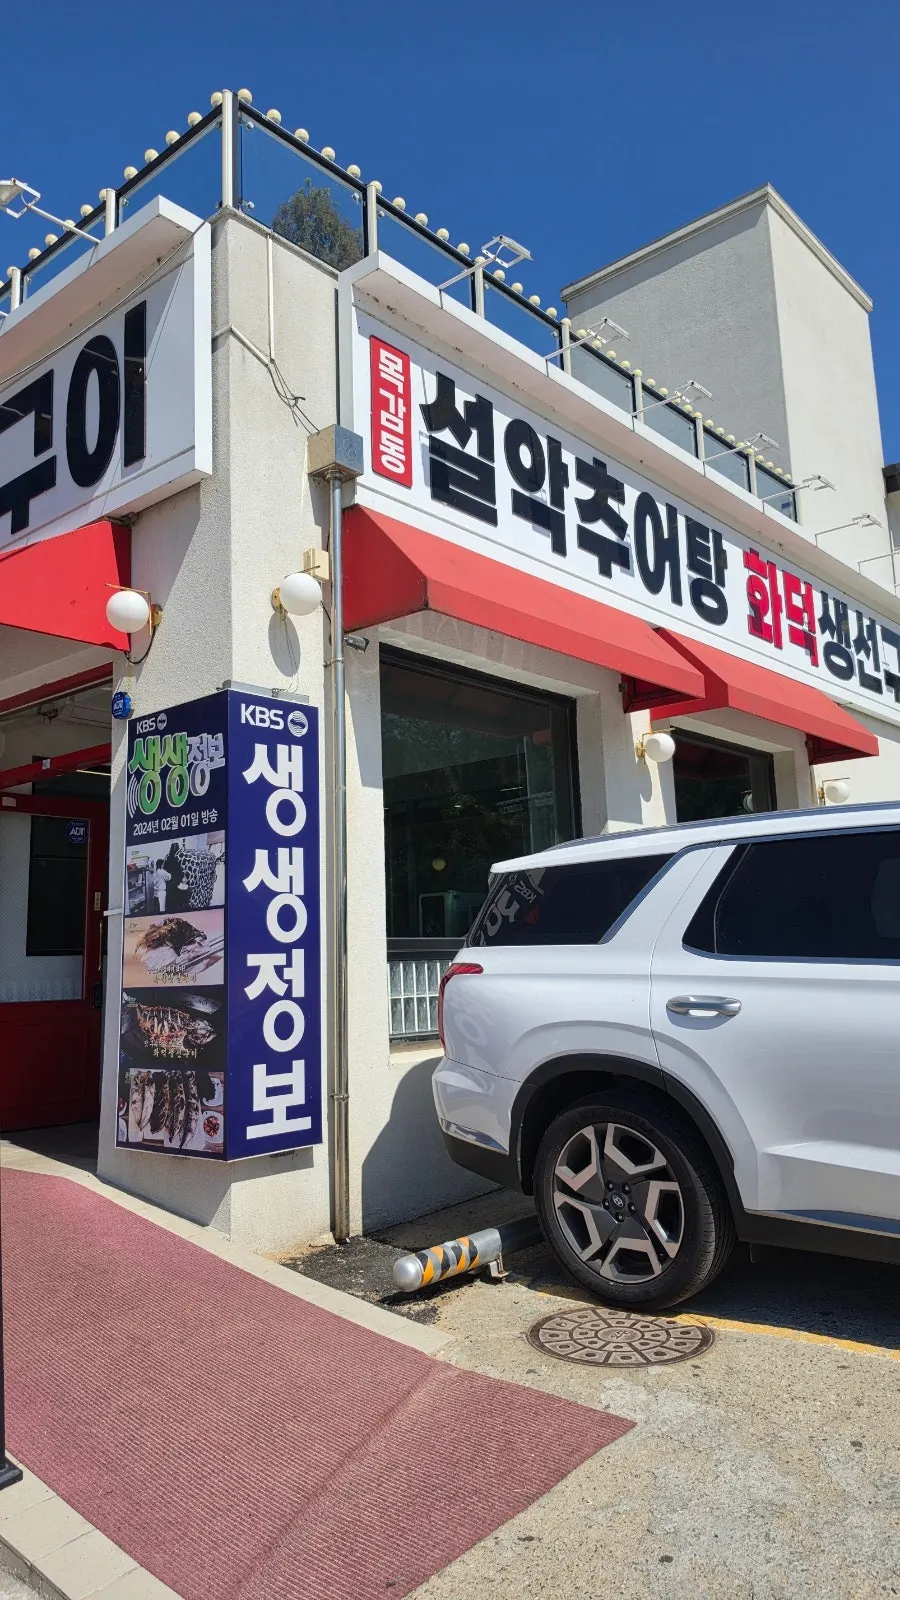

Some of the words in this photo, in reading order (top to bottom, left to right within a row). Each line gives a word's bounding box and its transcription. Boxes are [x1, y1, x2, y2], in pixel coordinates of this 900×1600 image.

[379, 348, 406, 475] 목감동
[136, 716, 157, 735] KBS
[240, 702, 285, 731] KBS
[128, 731, 226, 815] 생생정보
[69, 826, 86, 836] ADT
[133, 817, 160, 836] 2024년
[161, 813, 179, 831] 02월
[180, 810, 199, 828] 01일
[201, 807, 219, 824] 방송
[241, 742, 312, 1141] 생생정보
